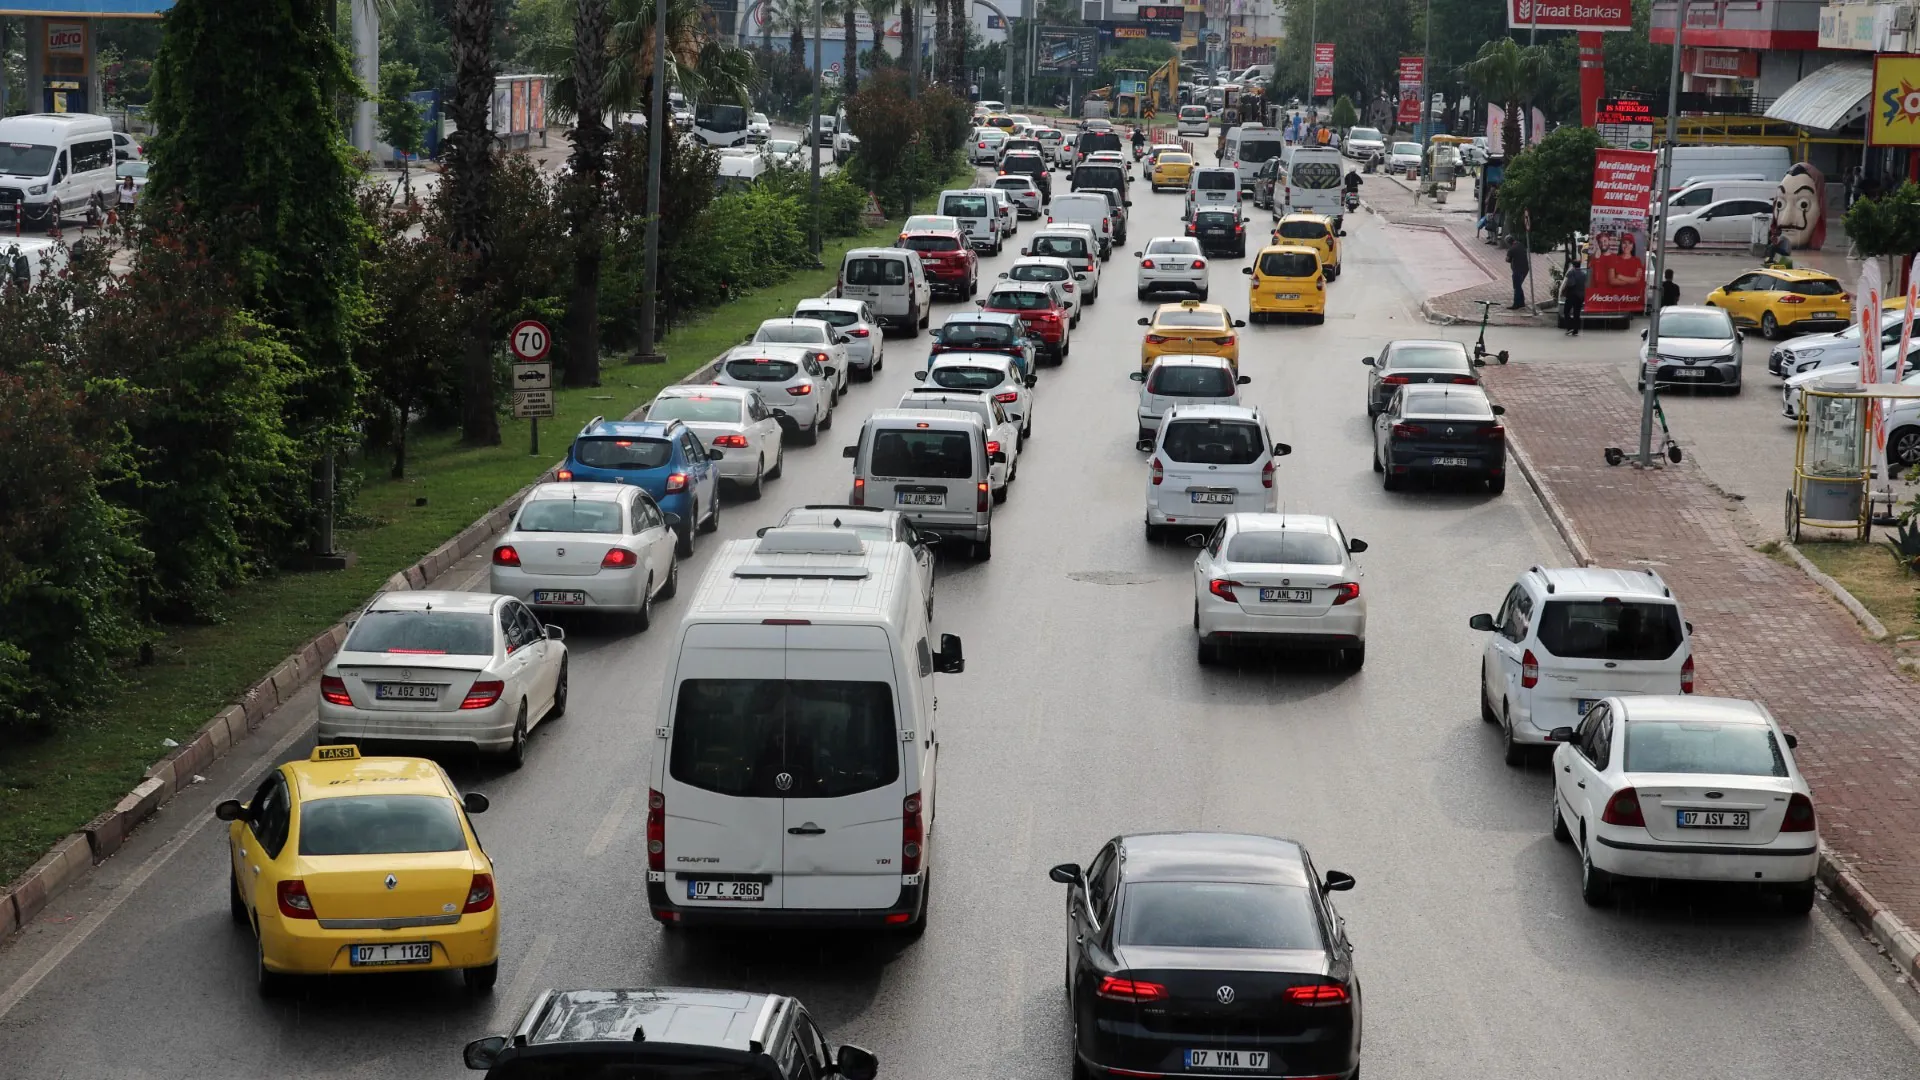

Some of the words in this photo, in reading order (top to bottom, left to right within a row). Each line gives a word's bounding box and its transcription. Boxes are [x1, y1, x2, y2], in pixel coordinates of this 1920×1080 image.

[1535, 3, 1571, 17] Ziraat
[1573, 4, 1622, 19] Bankası
[1598, 160, 1651, 173] MediaMarkt
[1611, 171, 1636, 181] şimdi
[1595, 180, 1650, 193] MarkAntalya
[1604, 191, 1639, 202] AVM'de!
[518, 332, 543, 352] 70
[539, 592, 549, 601] 07
[572, 593, 582, 601] 54
[1265, 590, 1275, 599] 07
[1277, 590, 1290, 599] ANL
[1295, 591, 1309, 600] 731
[382, 685, 393, 696] 54
[419, 686, 436, 697] 904
[1684, 812, 1697, 824] 07
[1704, 813, 1725, 825] ASV
[1733, 813, 1747, 826] 32
[676, 856, 720, 864] CRAFTER
[875, 858, 891, 866] TDI
[696, 881, 710, 895] 07
[717, 882, 724, 895] C
[732, 882, 760, 896] 2866
[359, 946, 374, 961] 07
[381, 946, 389, 959] T
[401, 944, 429, 959] 1128
[1192, 1050, 1207, 1066] 07
[1216, 1051, 1240, 1067] YMA
[1249, 1052, 1266, 1067] 07
